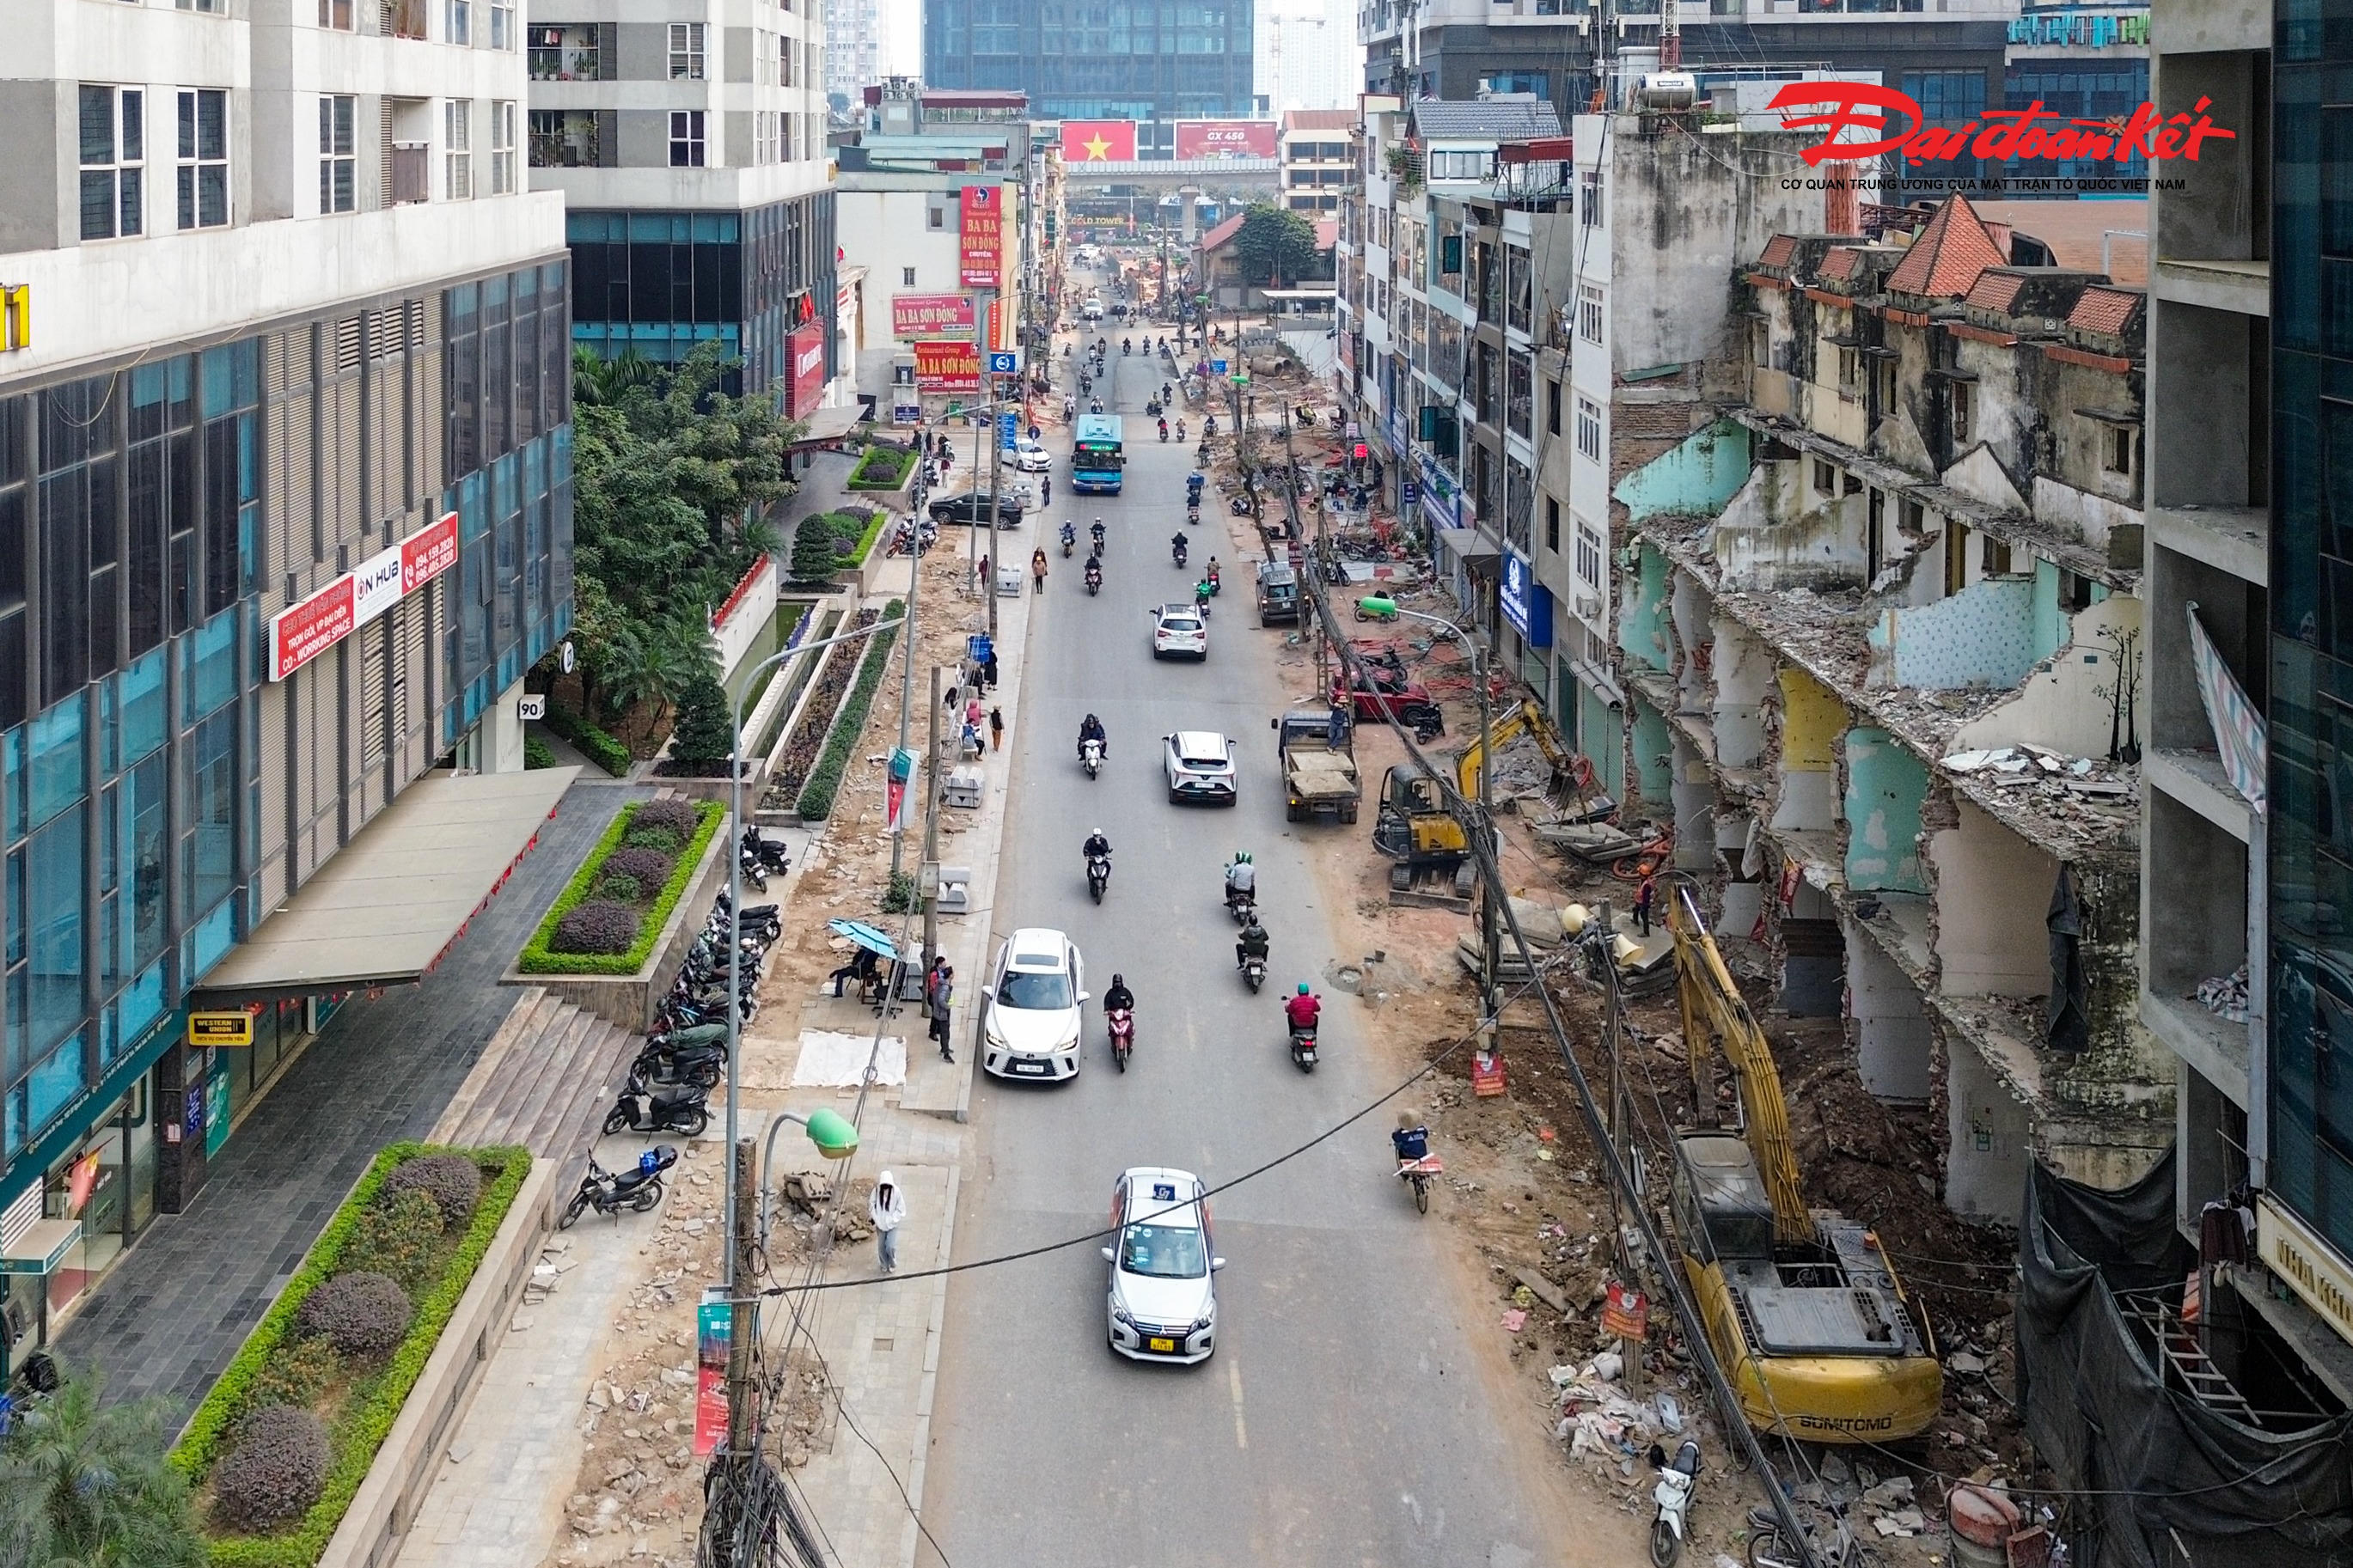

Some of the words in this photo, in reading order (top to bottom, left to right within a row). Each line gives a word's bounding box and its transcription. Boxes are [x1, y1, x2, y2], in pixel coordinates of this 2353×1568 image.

[967, 219, 981, 232] BA
[983, 219, 997, 232] BA
[963, 235, 978, 250] SƠN
[979, 234, 999, 250] ĐÔNG
[895, 309, 907, 324] BA
[908, 309, 919, 323] BA
[916, 358, 926, 374] BA
[929, 358, 940, 374] BA
[942, 357, 958, 374] SƠN
[376, 560, 399, 588] HUB
[282, 656, 293, 672] CO
[331, 617, 351, 639] SPACE
[522, 703, 538, 716] 90
[2276, 1236, 2315, 1294] NHA
